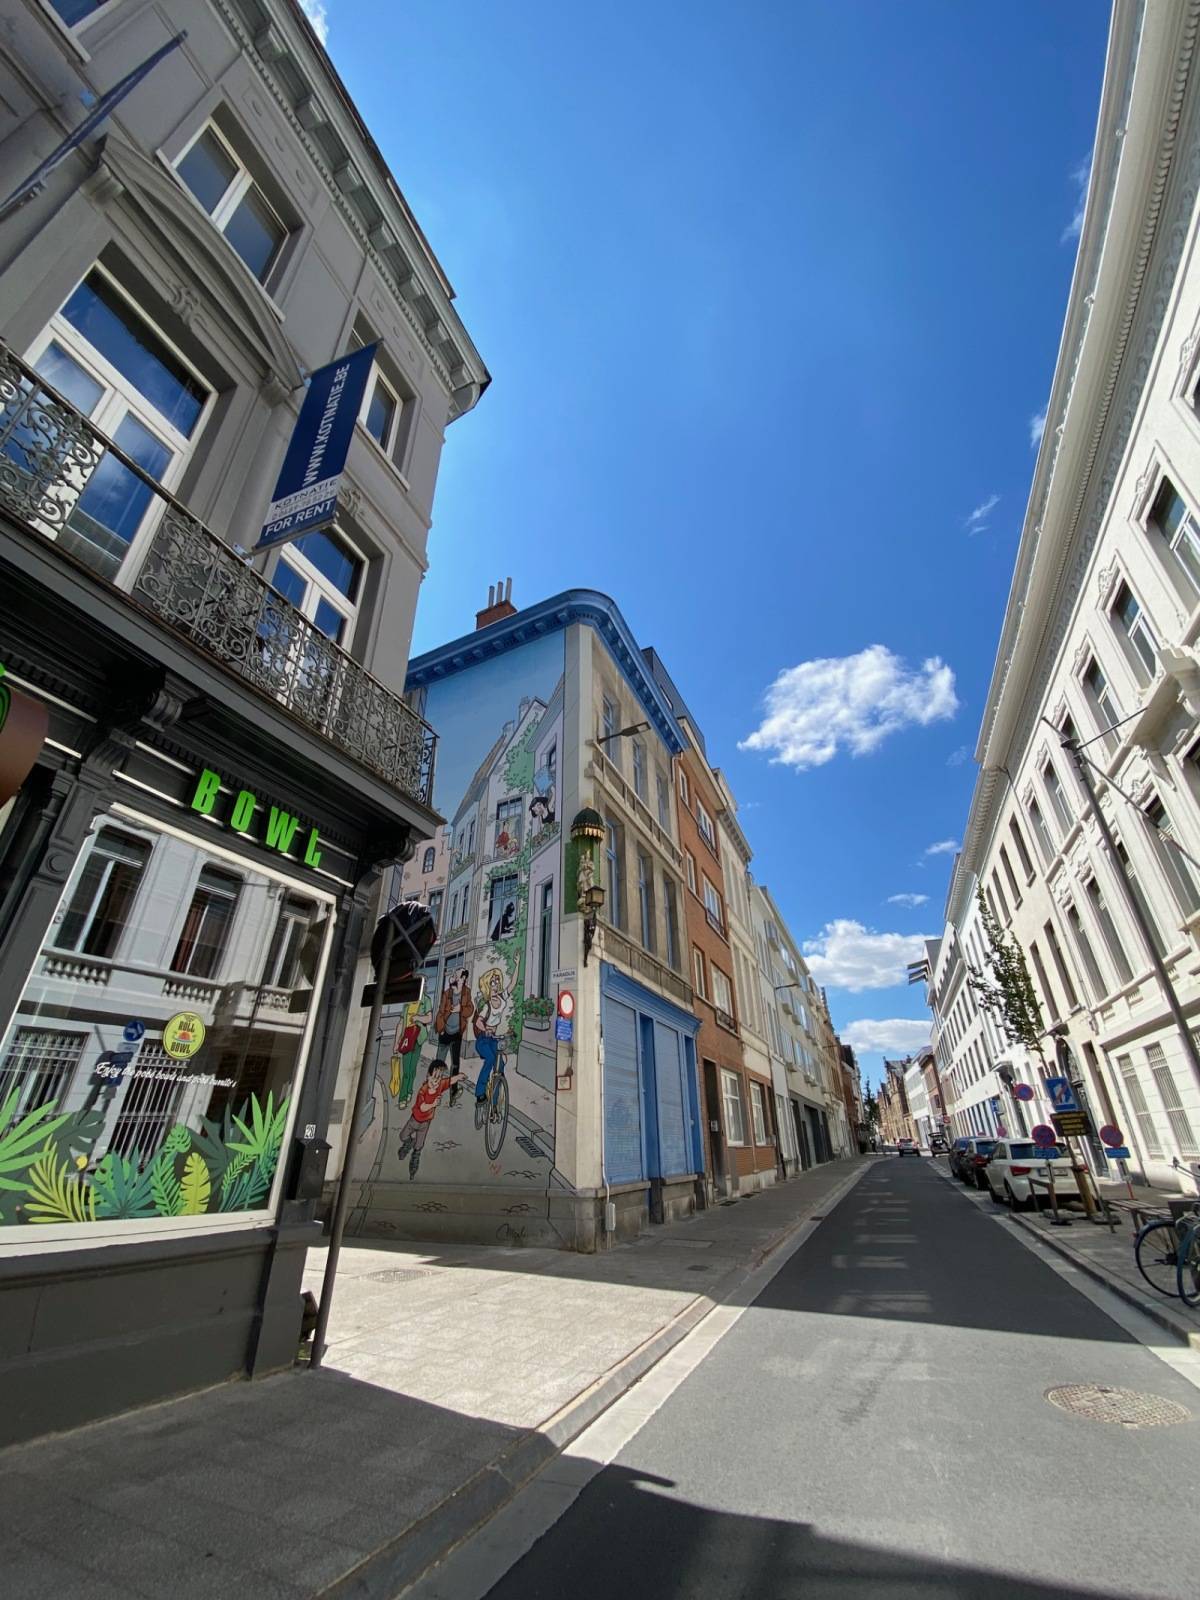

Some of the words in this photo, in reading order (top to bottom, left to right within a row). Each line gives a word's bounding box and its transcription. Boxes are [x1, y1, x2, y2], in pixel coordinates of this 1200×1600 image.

[302, 363, 350, 488] WWW.KOTNATIE.BE
[275, 480, 337, 510] KOTNATIE
[264, 516, 293, 536] FOR
[295, 498, 335, 524] RENT
[191, 768, 322, 868] BOWL
[95, 1061, 121, 1078] Enjoy
